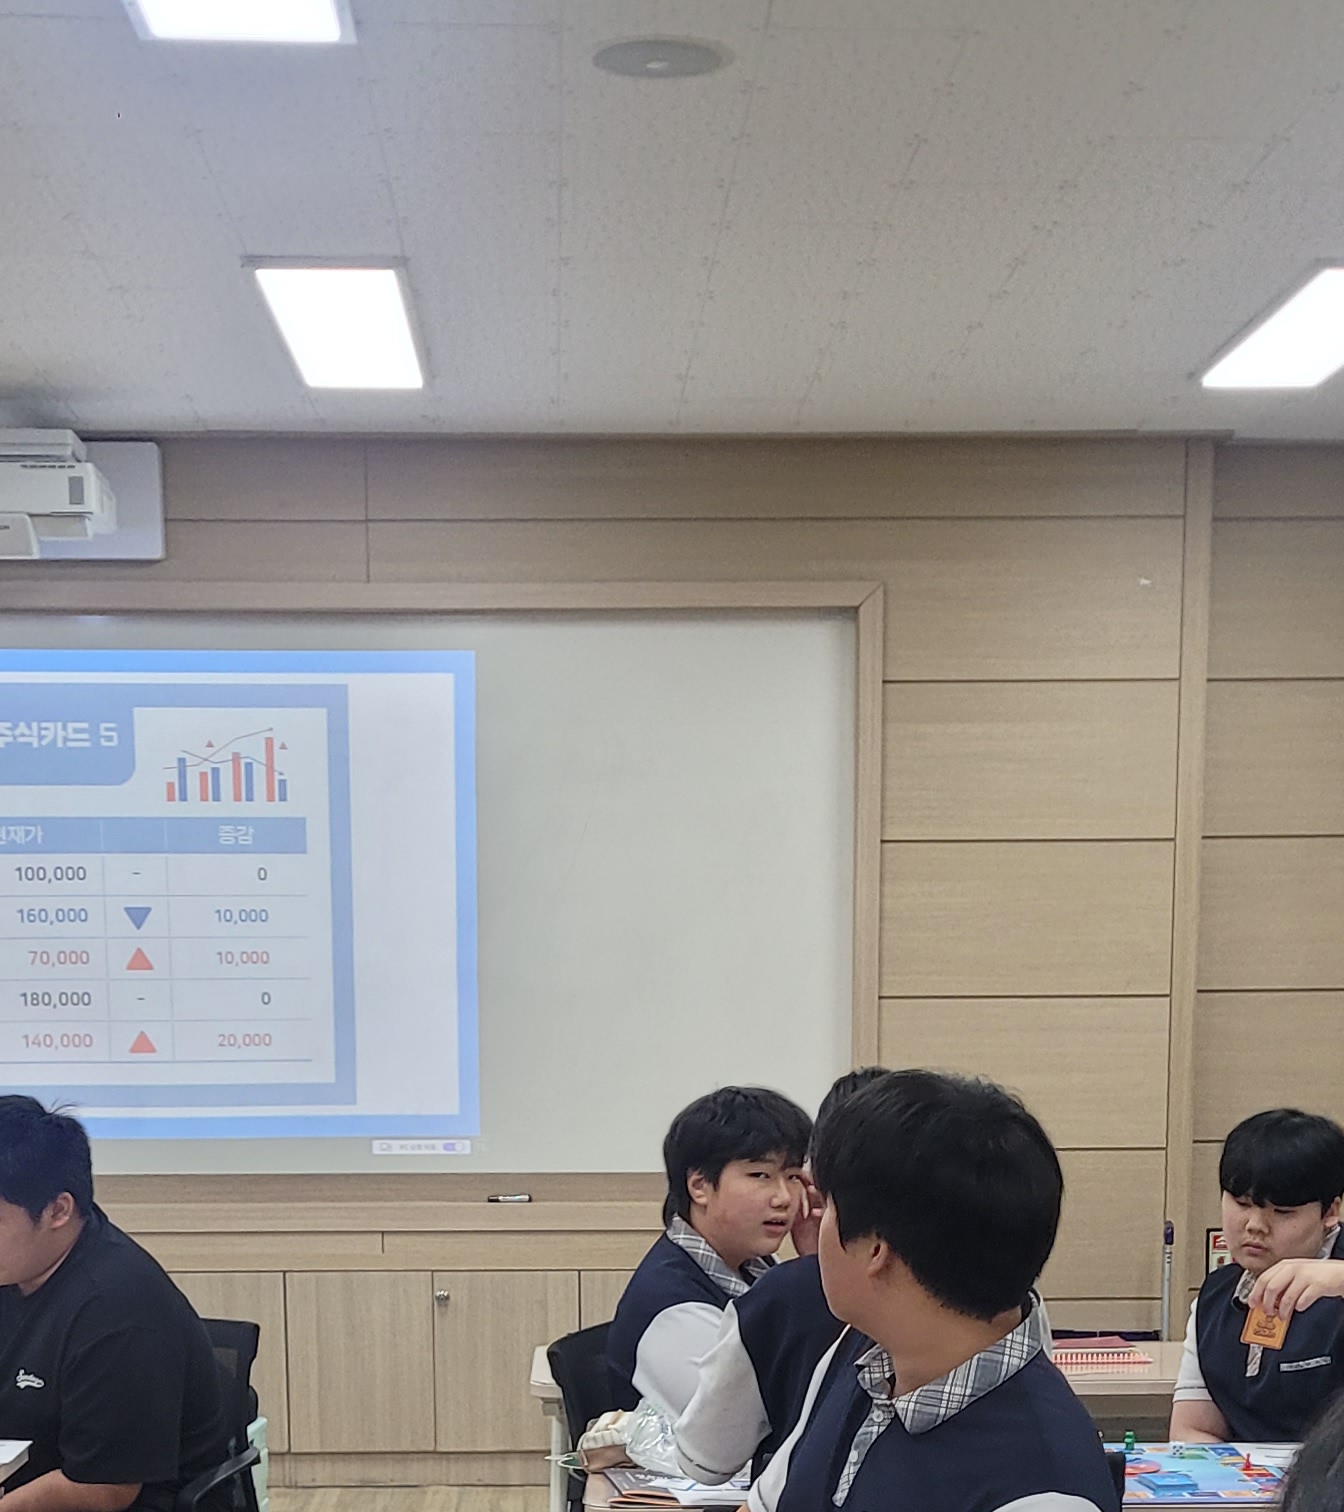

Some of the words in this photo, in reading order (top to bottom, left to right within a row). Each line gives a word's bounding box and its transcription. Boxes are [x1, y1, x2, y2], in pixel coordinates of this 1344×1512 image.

[99, 722, 119, 747] 5
[218, 825, 255, 845] 증감
[14, 865, 87, 884] 100,000
[257, 866, 268, 881] 0
[16, 907, 89, 926] 160,000
[214, 908, 269, 925] 10,000
[27, 950, 90, 968] 70,000
[216, 950, 270, 967] 10,000
[19, 991, 92, 1010] 180,000
[260, 991, 272, 1006] 0
[21, 1033, 94, 1051] 140,000
[217, 1032, 273, 1050] 20,000
